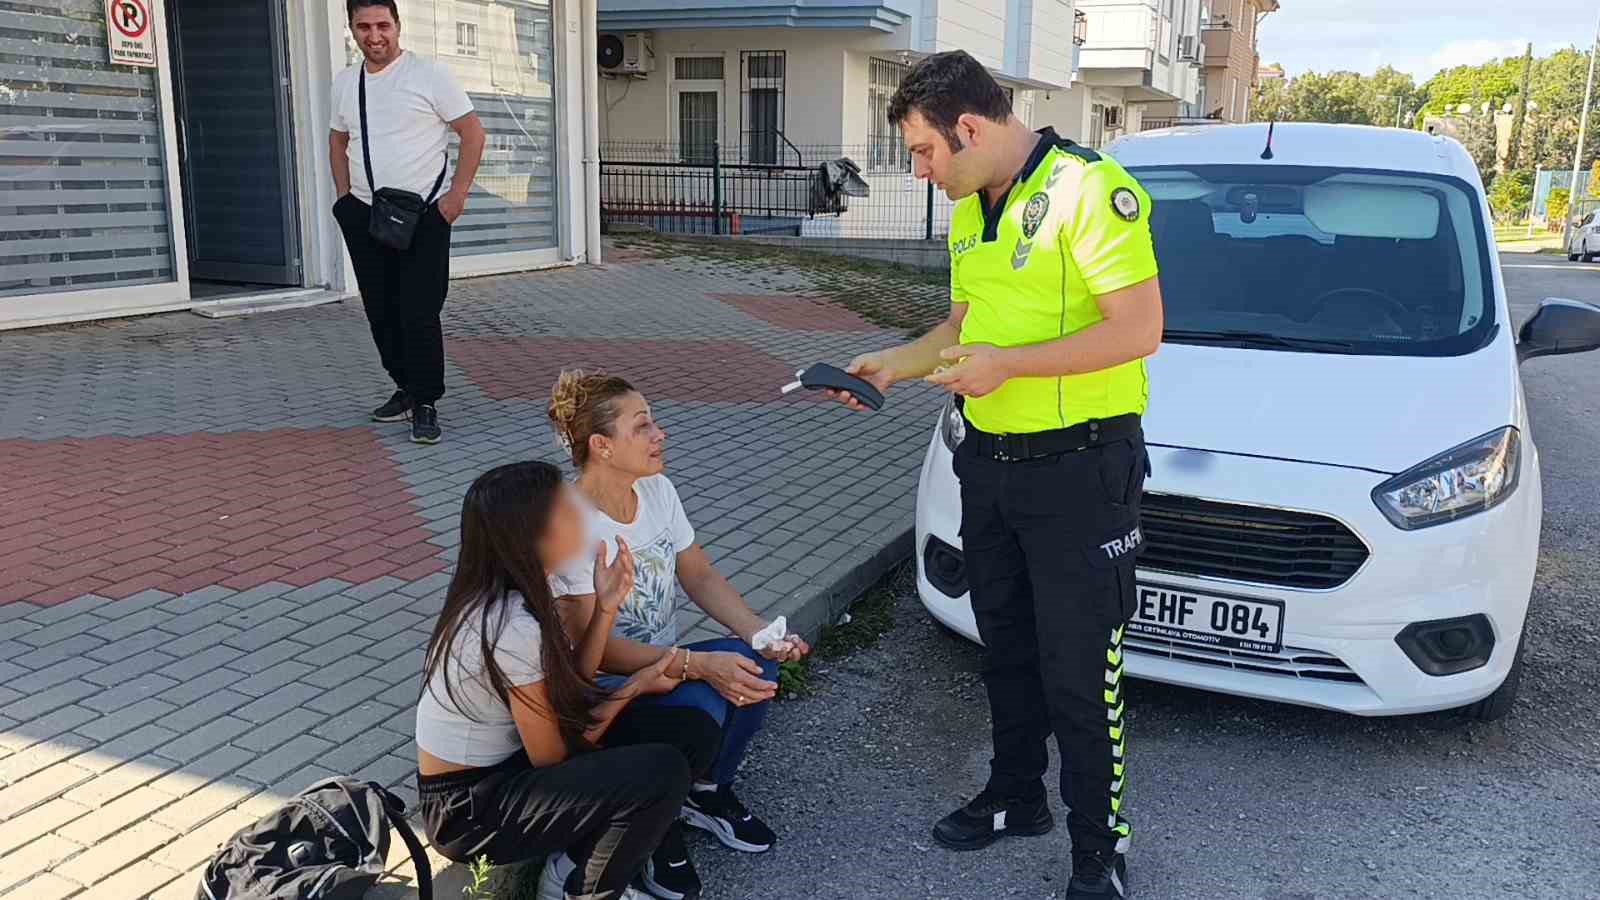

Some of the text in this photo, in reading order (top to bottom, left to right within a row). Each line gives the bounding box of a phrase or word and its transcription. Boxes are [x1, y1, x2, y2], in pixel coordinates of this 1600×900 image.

[114, 49, 126, 57] PARK
[1139, 588, 1269, 638] EHF 084
